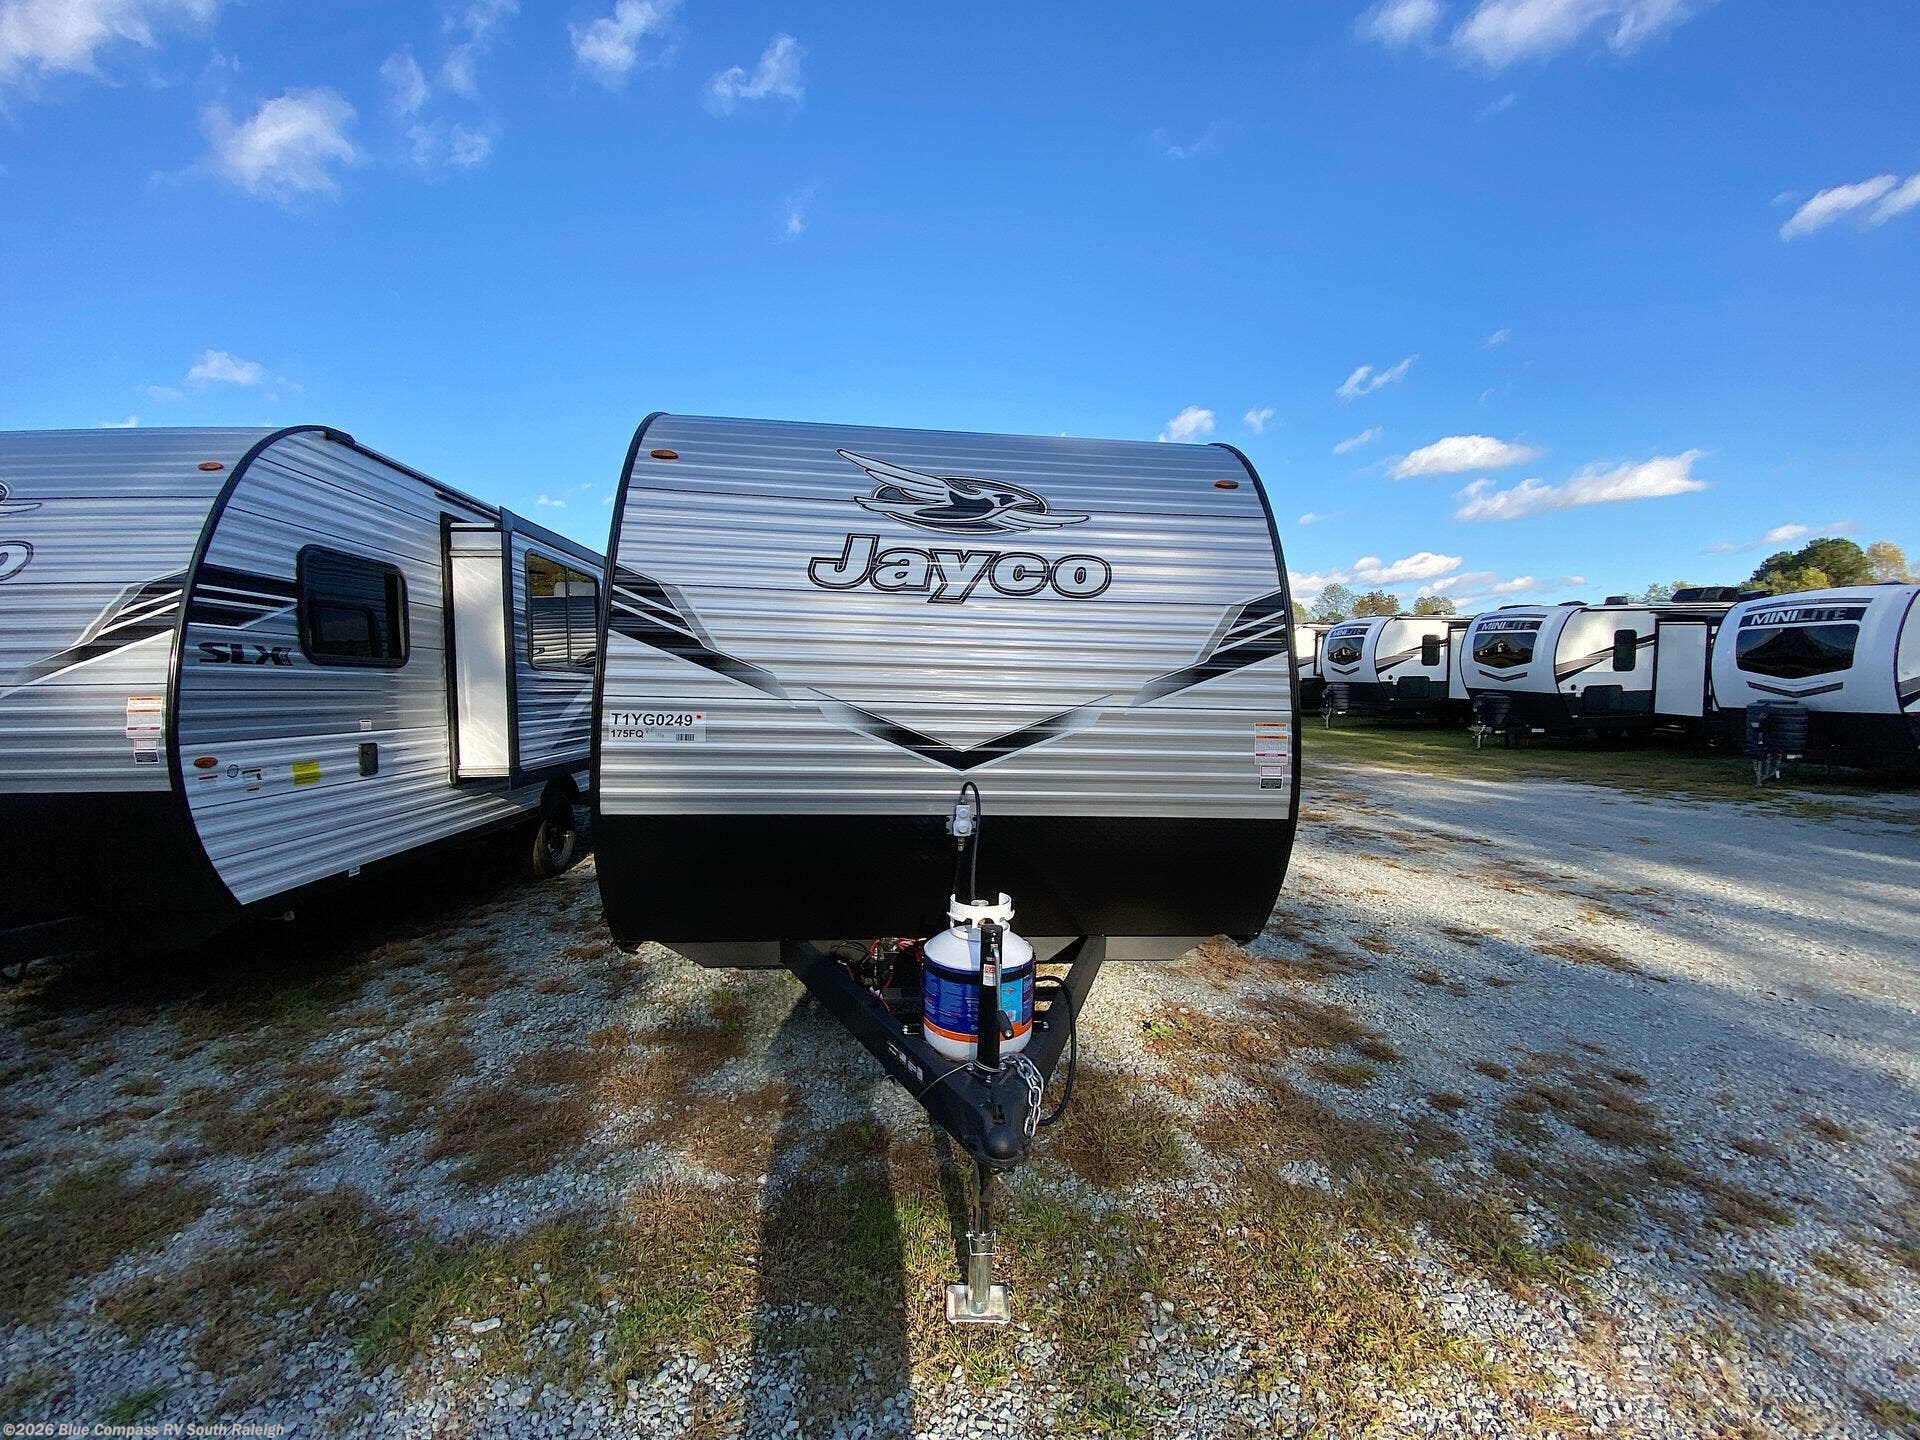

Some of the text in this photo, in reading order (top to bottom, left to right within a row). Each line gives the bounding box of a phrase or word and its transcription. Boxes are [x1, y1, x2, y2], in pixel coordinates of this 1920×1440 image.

[807, 533, 1112, 605] Jayco
[197, 641, 293, 667] SLX
[611, 712, 693, 727] T1YG0249
[610, 729, 644, 739] 175FQ
